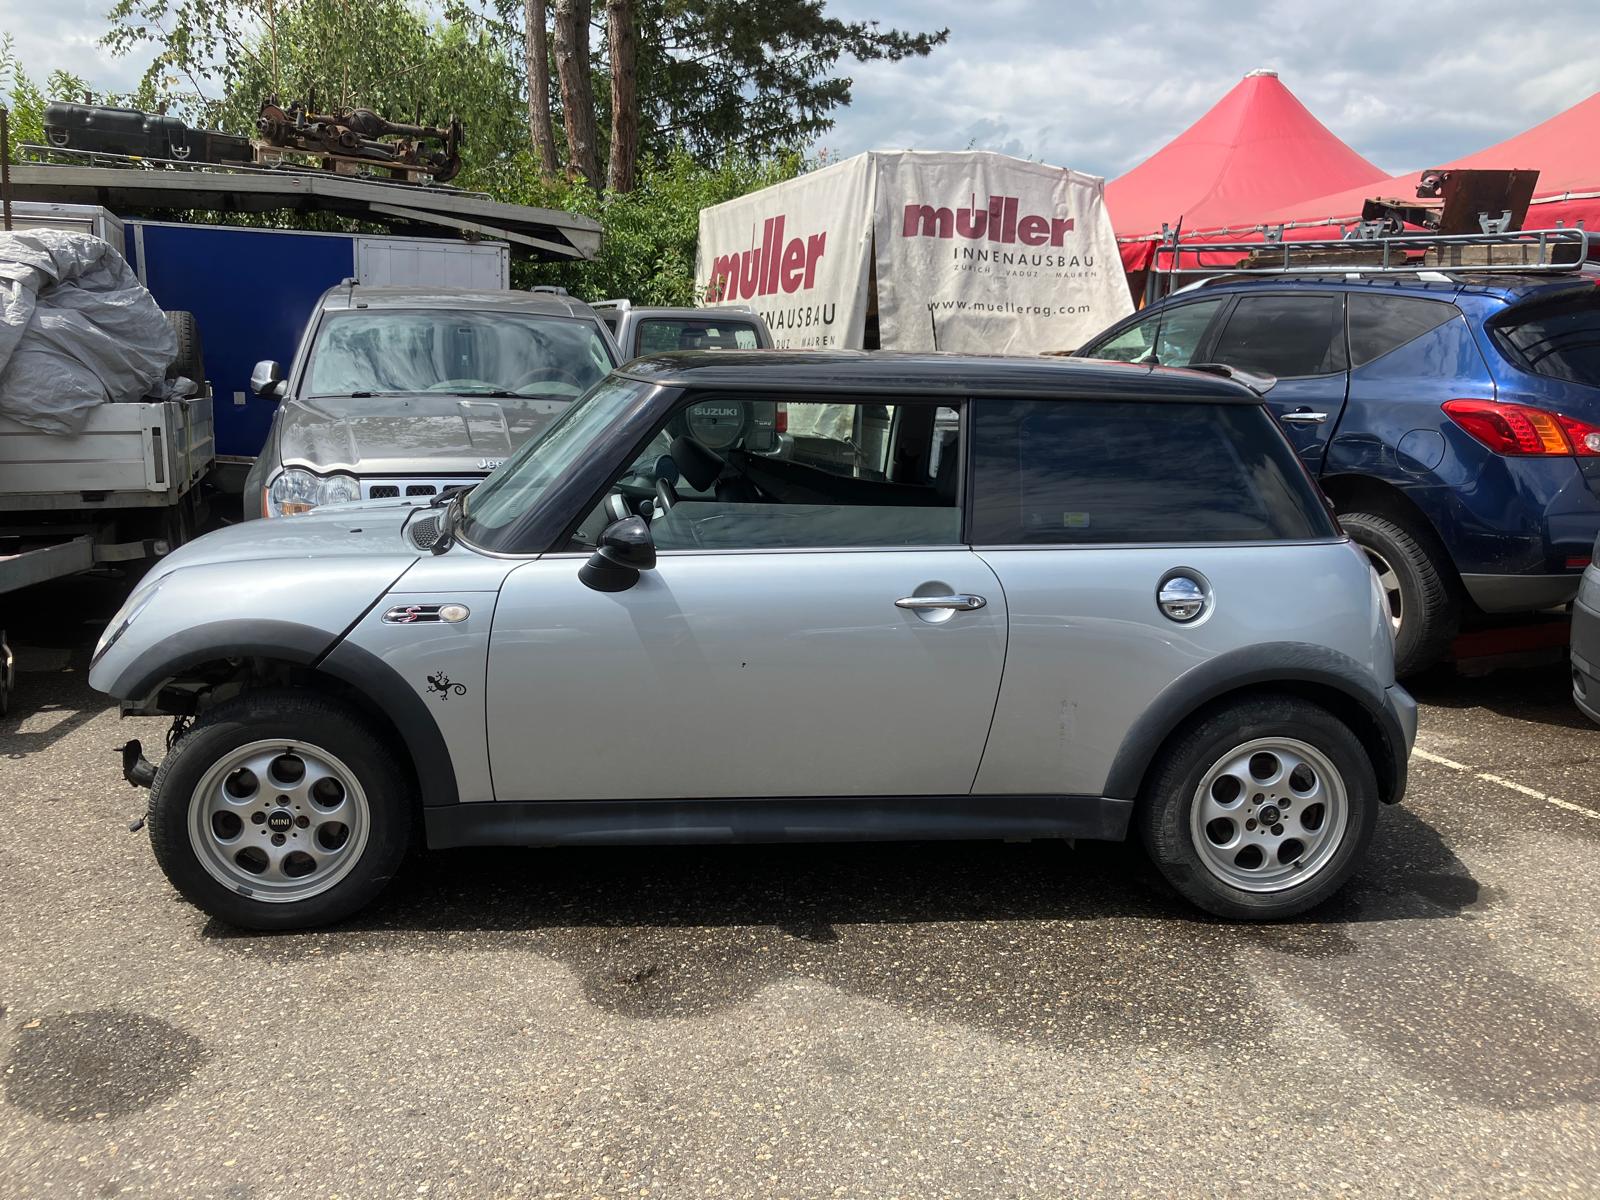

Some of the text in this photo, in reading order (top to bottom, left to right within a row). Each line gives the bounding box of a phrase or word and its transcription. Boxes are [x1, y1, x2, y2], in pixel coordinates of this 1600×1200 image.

[953, 247, 1095, 268] INNENAUSBAU
[1005, 270, 1039, 278] VADUZ
[1055, 271, 1097, 280] MAUREN
[927, 300, 1090, 318] www.muellerag.com
[694, 407, 738, 417] SUZUKI
[271, 818, 290, 826] MINI
